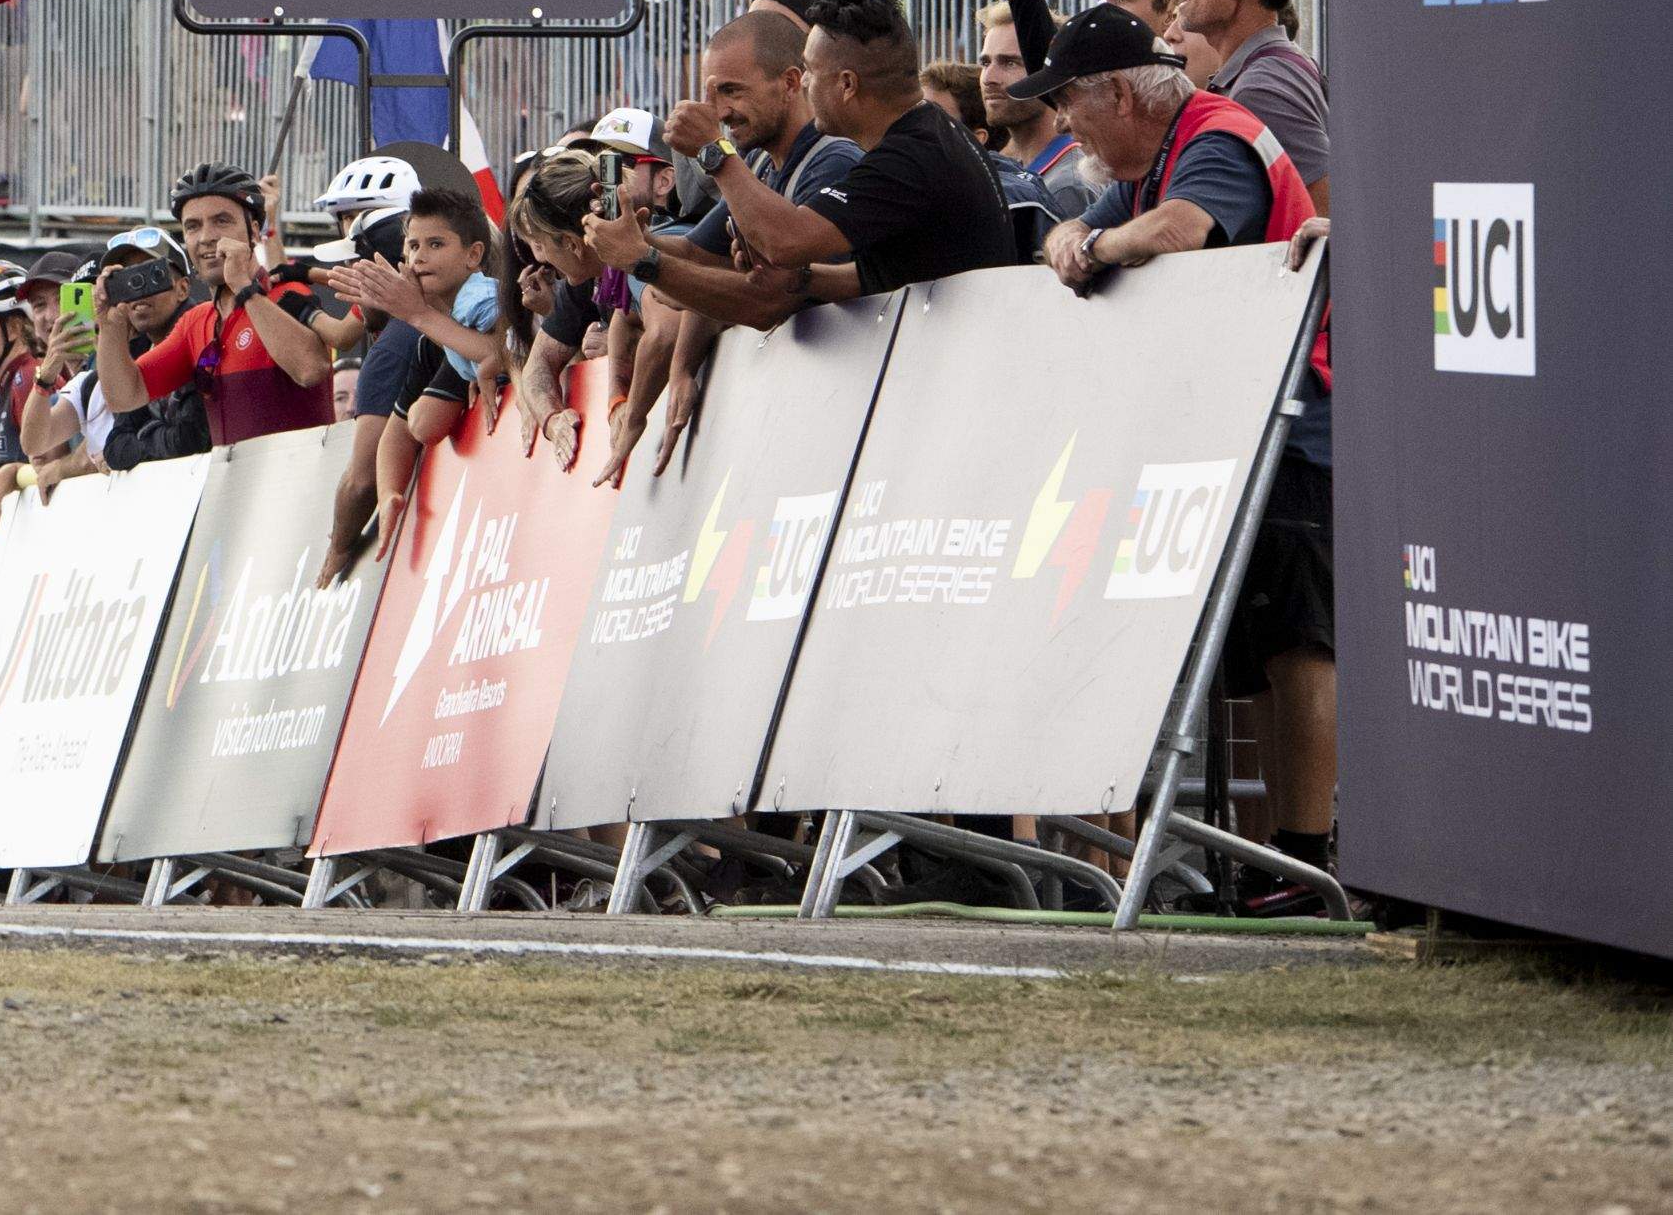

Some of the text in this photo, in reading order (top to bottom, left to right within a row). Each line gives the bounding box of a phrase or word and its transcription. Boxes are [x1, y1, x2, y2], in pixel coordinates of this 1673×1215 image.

[1450, 218, 1525, 339] UCI
[469, 512, 519, 590] PAL
[838, 519, 1013, 564] MOUNTAIN BIKE
[1135, 486, 1222, 574] UCI
[826, 565, 997, 610] WORLD SERIES
[1409, 543, 1437, 593] UCI
[21, 557, 146, 703] vittoria
[199, 546, 362, 684] Andorra
[447, 577, 550, 666] ARINSAL
[590, 606, 647, 643] WORLD
[1405, 600, 1591, 673] MOUNTAIN BIKE
[210, 698, 327, 757] visitandorra.com
[1407, 658, 1593, 734] WORLD SERIES
[421, 731, 464, 770] ANDORRA
